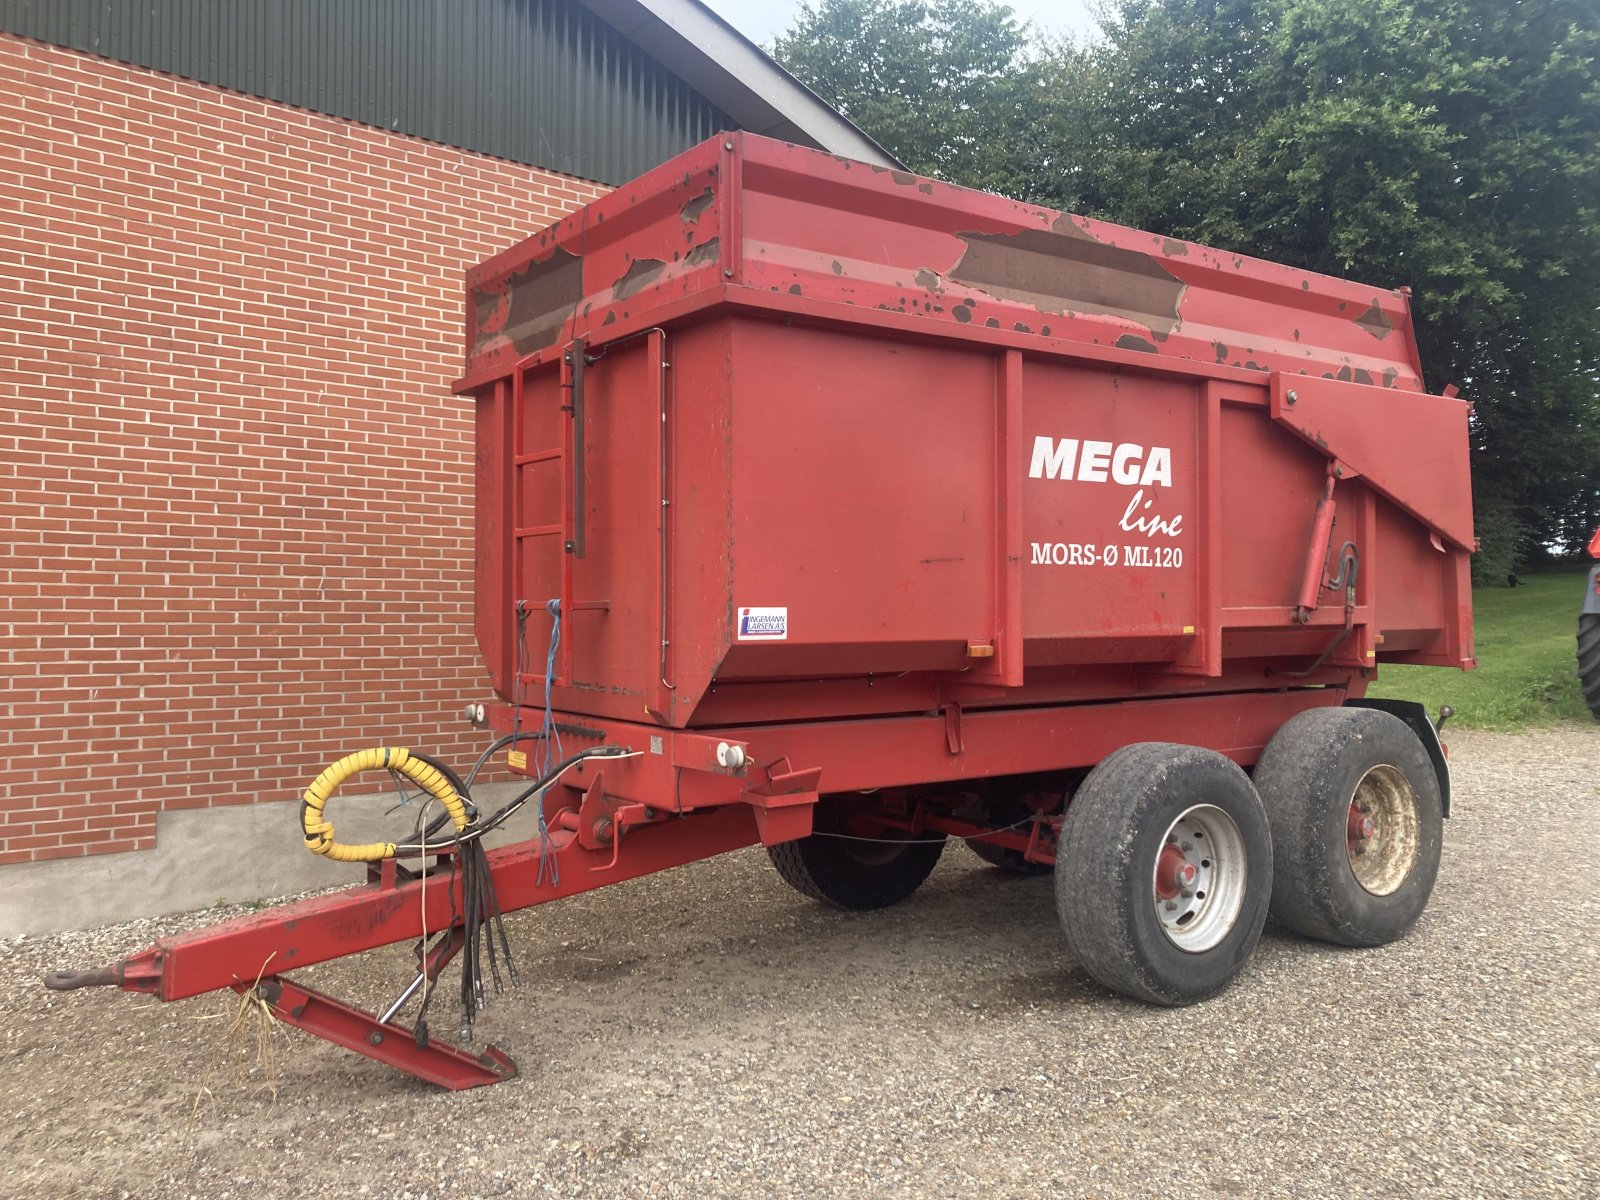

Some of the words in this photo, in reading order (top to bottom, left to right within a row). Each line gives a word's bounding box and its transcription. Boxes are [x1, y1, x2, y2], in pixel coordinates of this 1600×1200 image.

[1028, 435, 1172, 487] MEGA
[1118, 489, 1183, 537] line
[1030, 542, 1118, 567] MORS-Ø
[1123, 545, 1183, 568] ML120
[748, 615, 785, 623] INGEMANN
